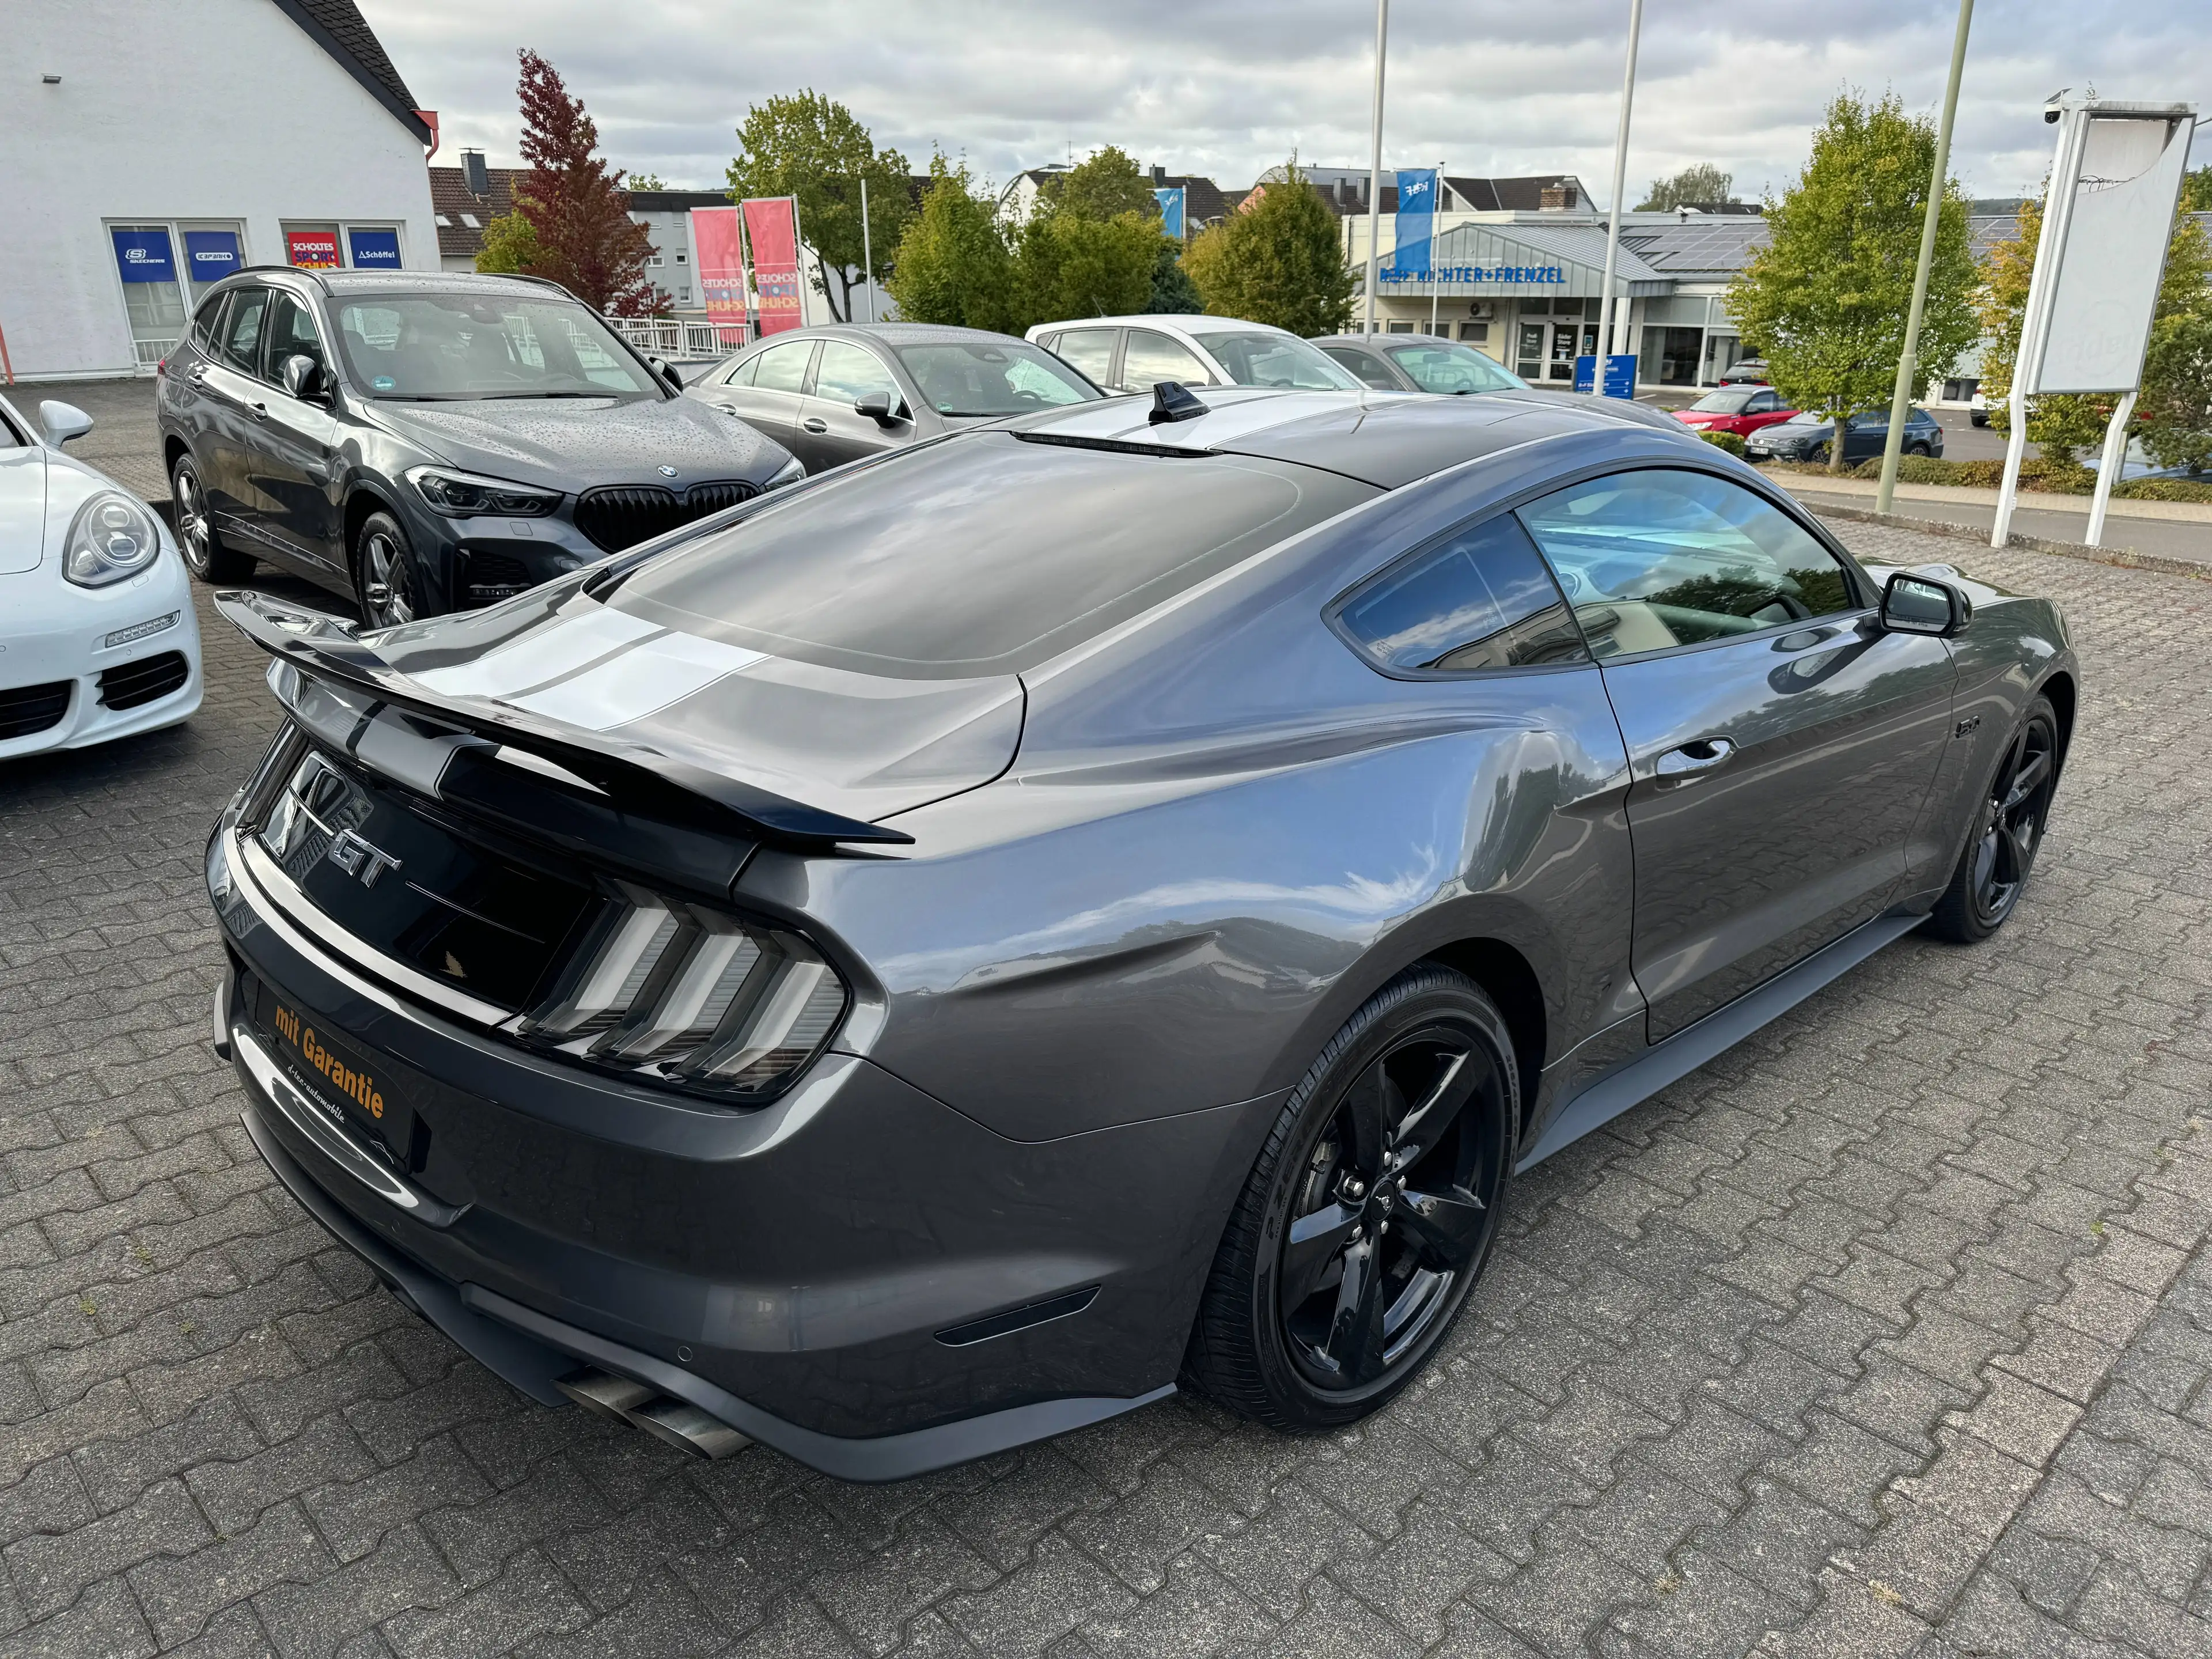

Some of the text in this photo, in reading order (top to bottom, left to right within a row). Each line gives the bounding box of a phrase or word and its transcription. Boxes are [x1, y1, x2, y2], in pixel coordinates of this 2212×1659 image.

[293, 243, 334, 251] SCHOLTES
[295, 252, 335, 262] SPORT
[328, 828, 403, 889] GT
[275, 1005, 384, 1119] mit Garantie
[287, 1065, 345, 1124] d-tec-automobile
